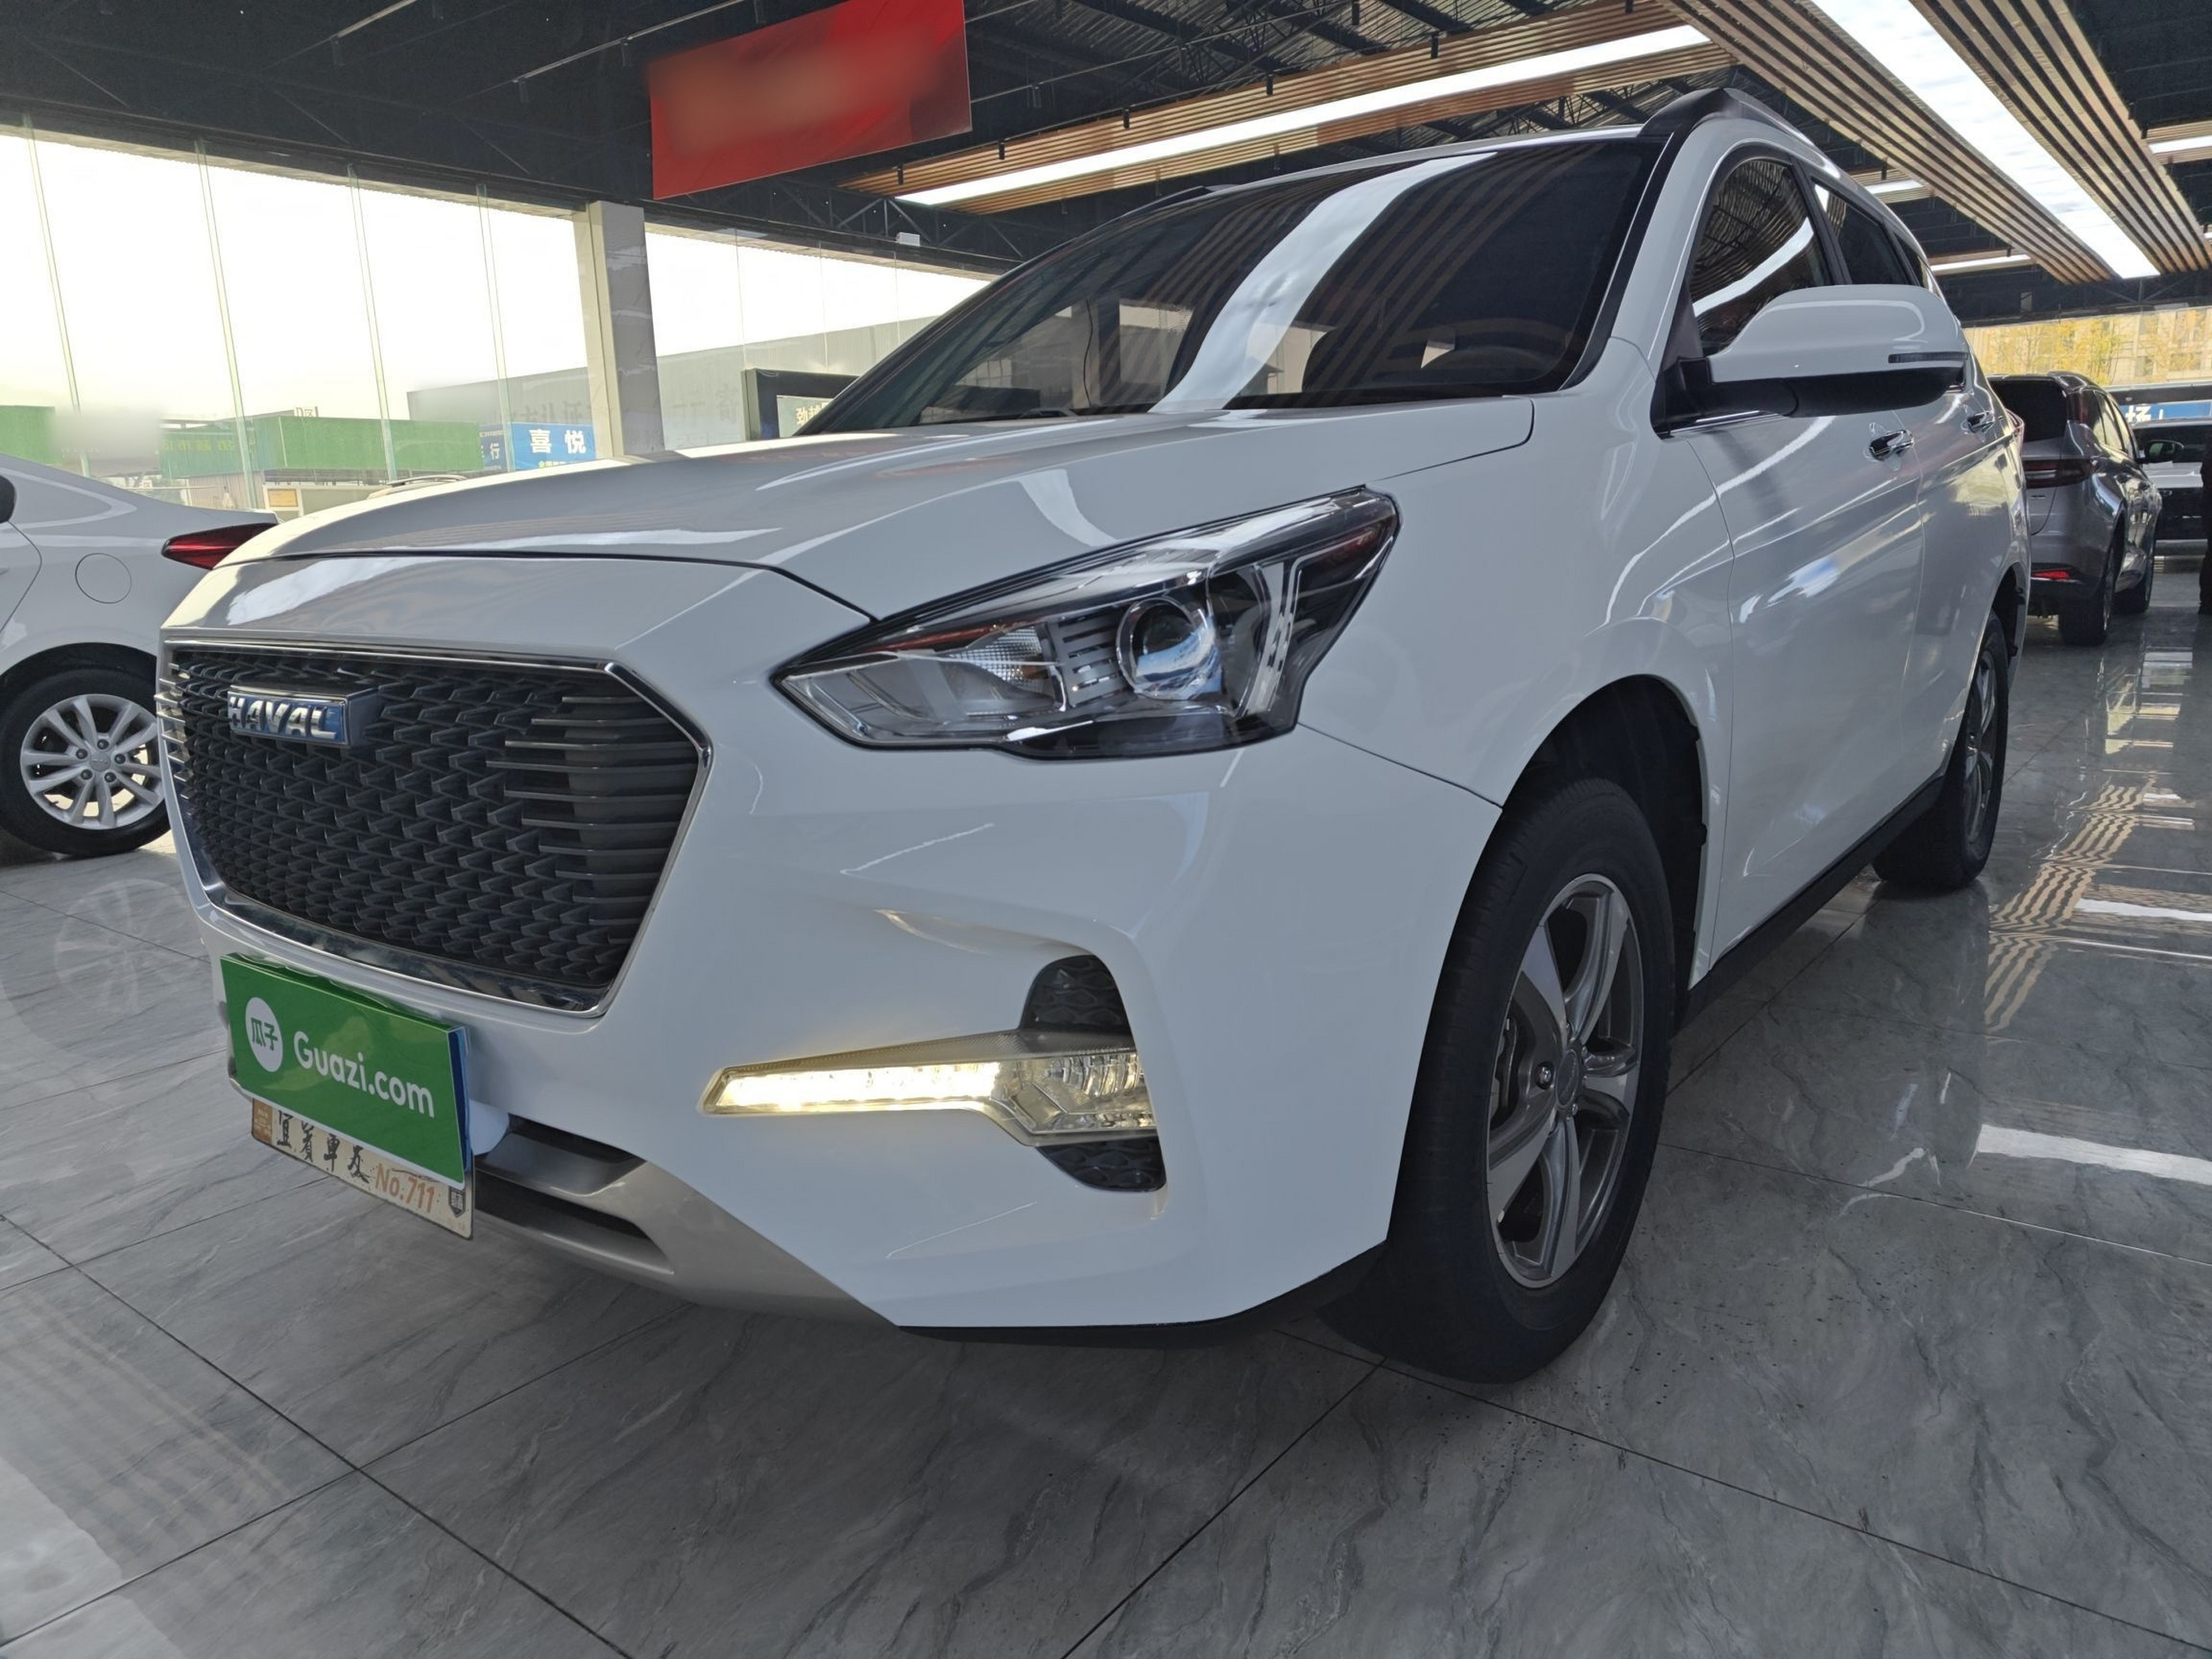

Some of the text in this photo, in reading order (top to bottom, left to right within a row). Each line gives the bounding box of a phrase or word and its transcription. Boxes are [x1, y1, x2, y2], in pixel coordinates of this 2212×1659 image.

[228, 696, 337, 739] HAVAL
[251, 1018, 278, 1051] 瓜子
[294, 1031, 435, 1118] Guazi.com
[376, 1163, 435, 1214] No.711
